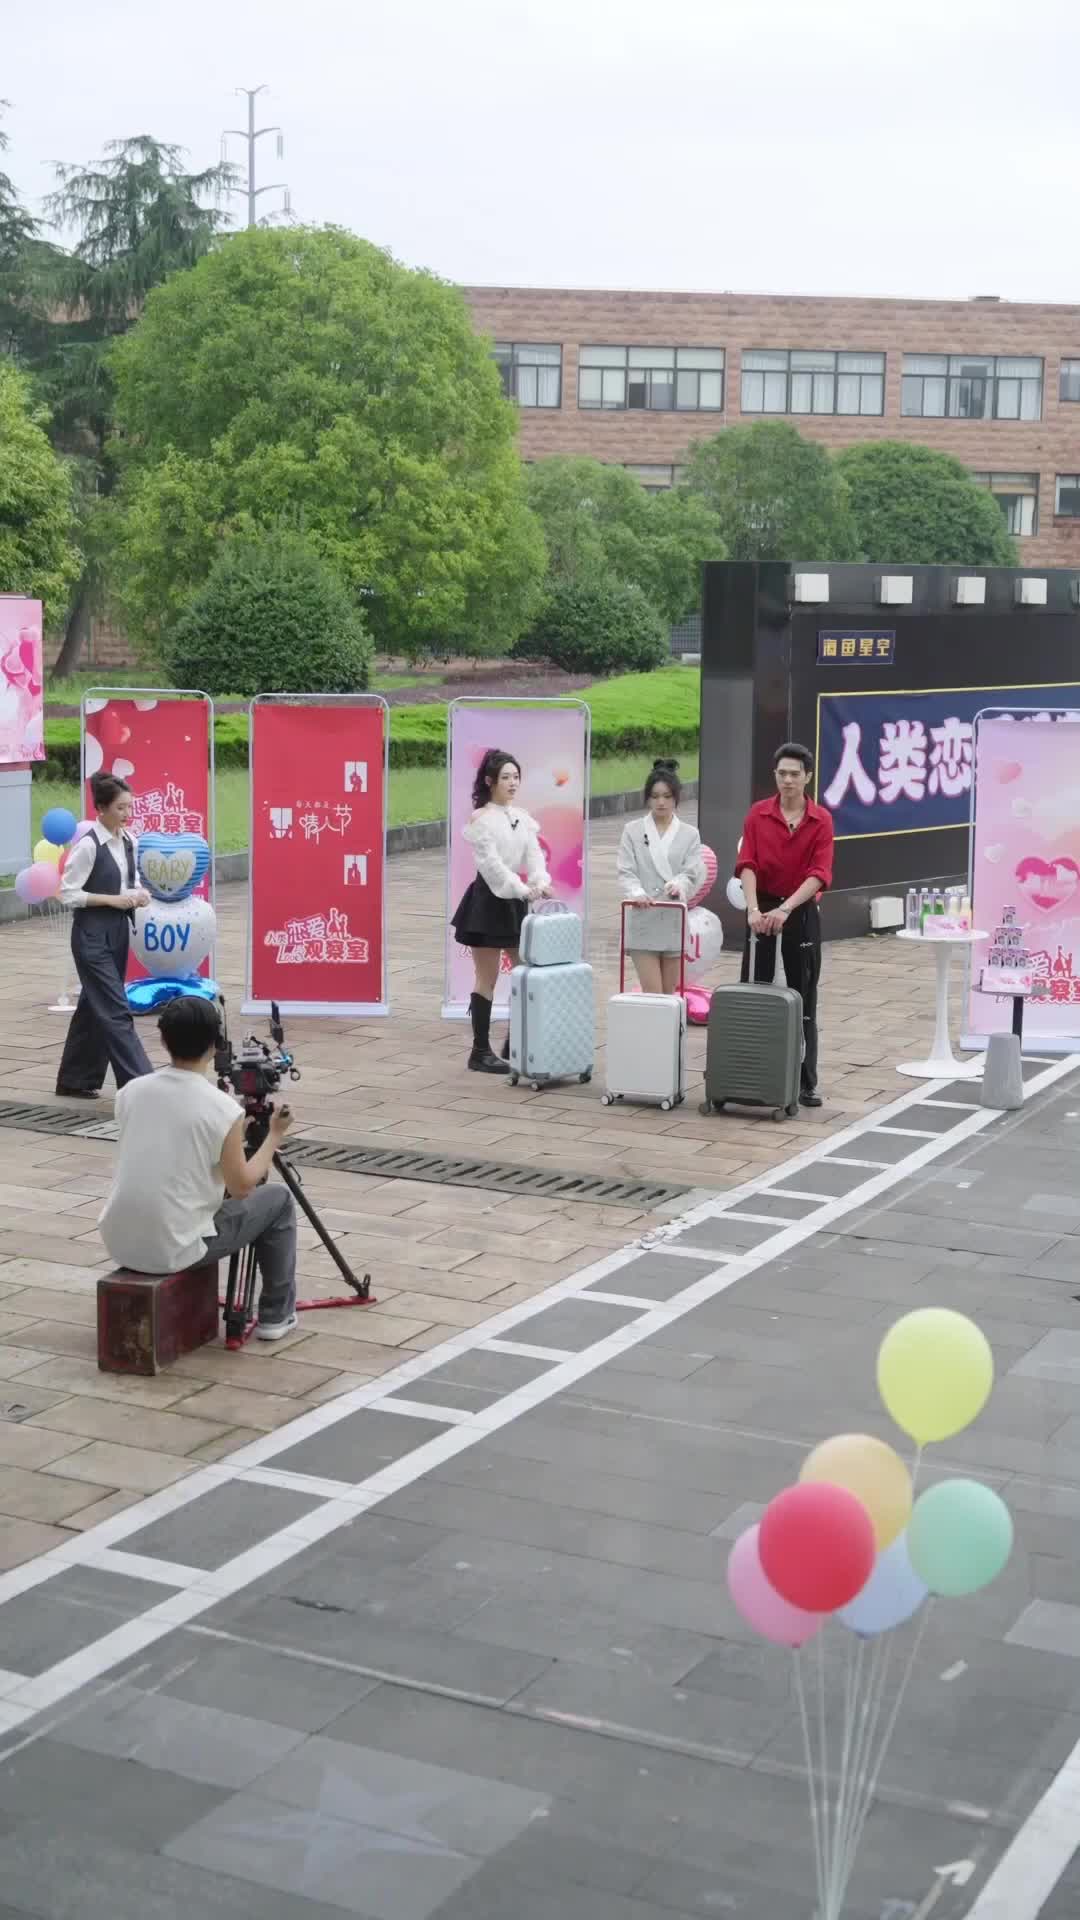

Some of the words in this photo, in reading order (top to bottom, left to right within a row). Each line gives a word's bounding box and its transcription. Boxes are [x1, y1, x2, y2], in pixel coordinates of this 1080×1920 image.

[143, 814, 202, 833] 观察室
[299, 803, 353, 846] 情人节
[147, 857, 192, 882] BABY
[144, 922, 191, 953] BOY
